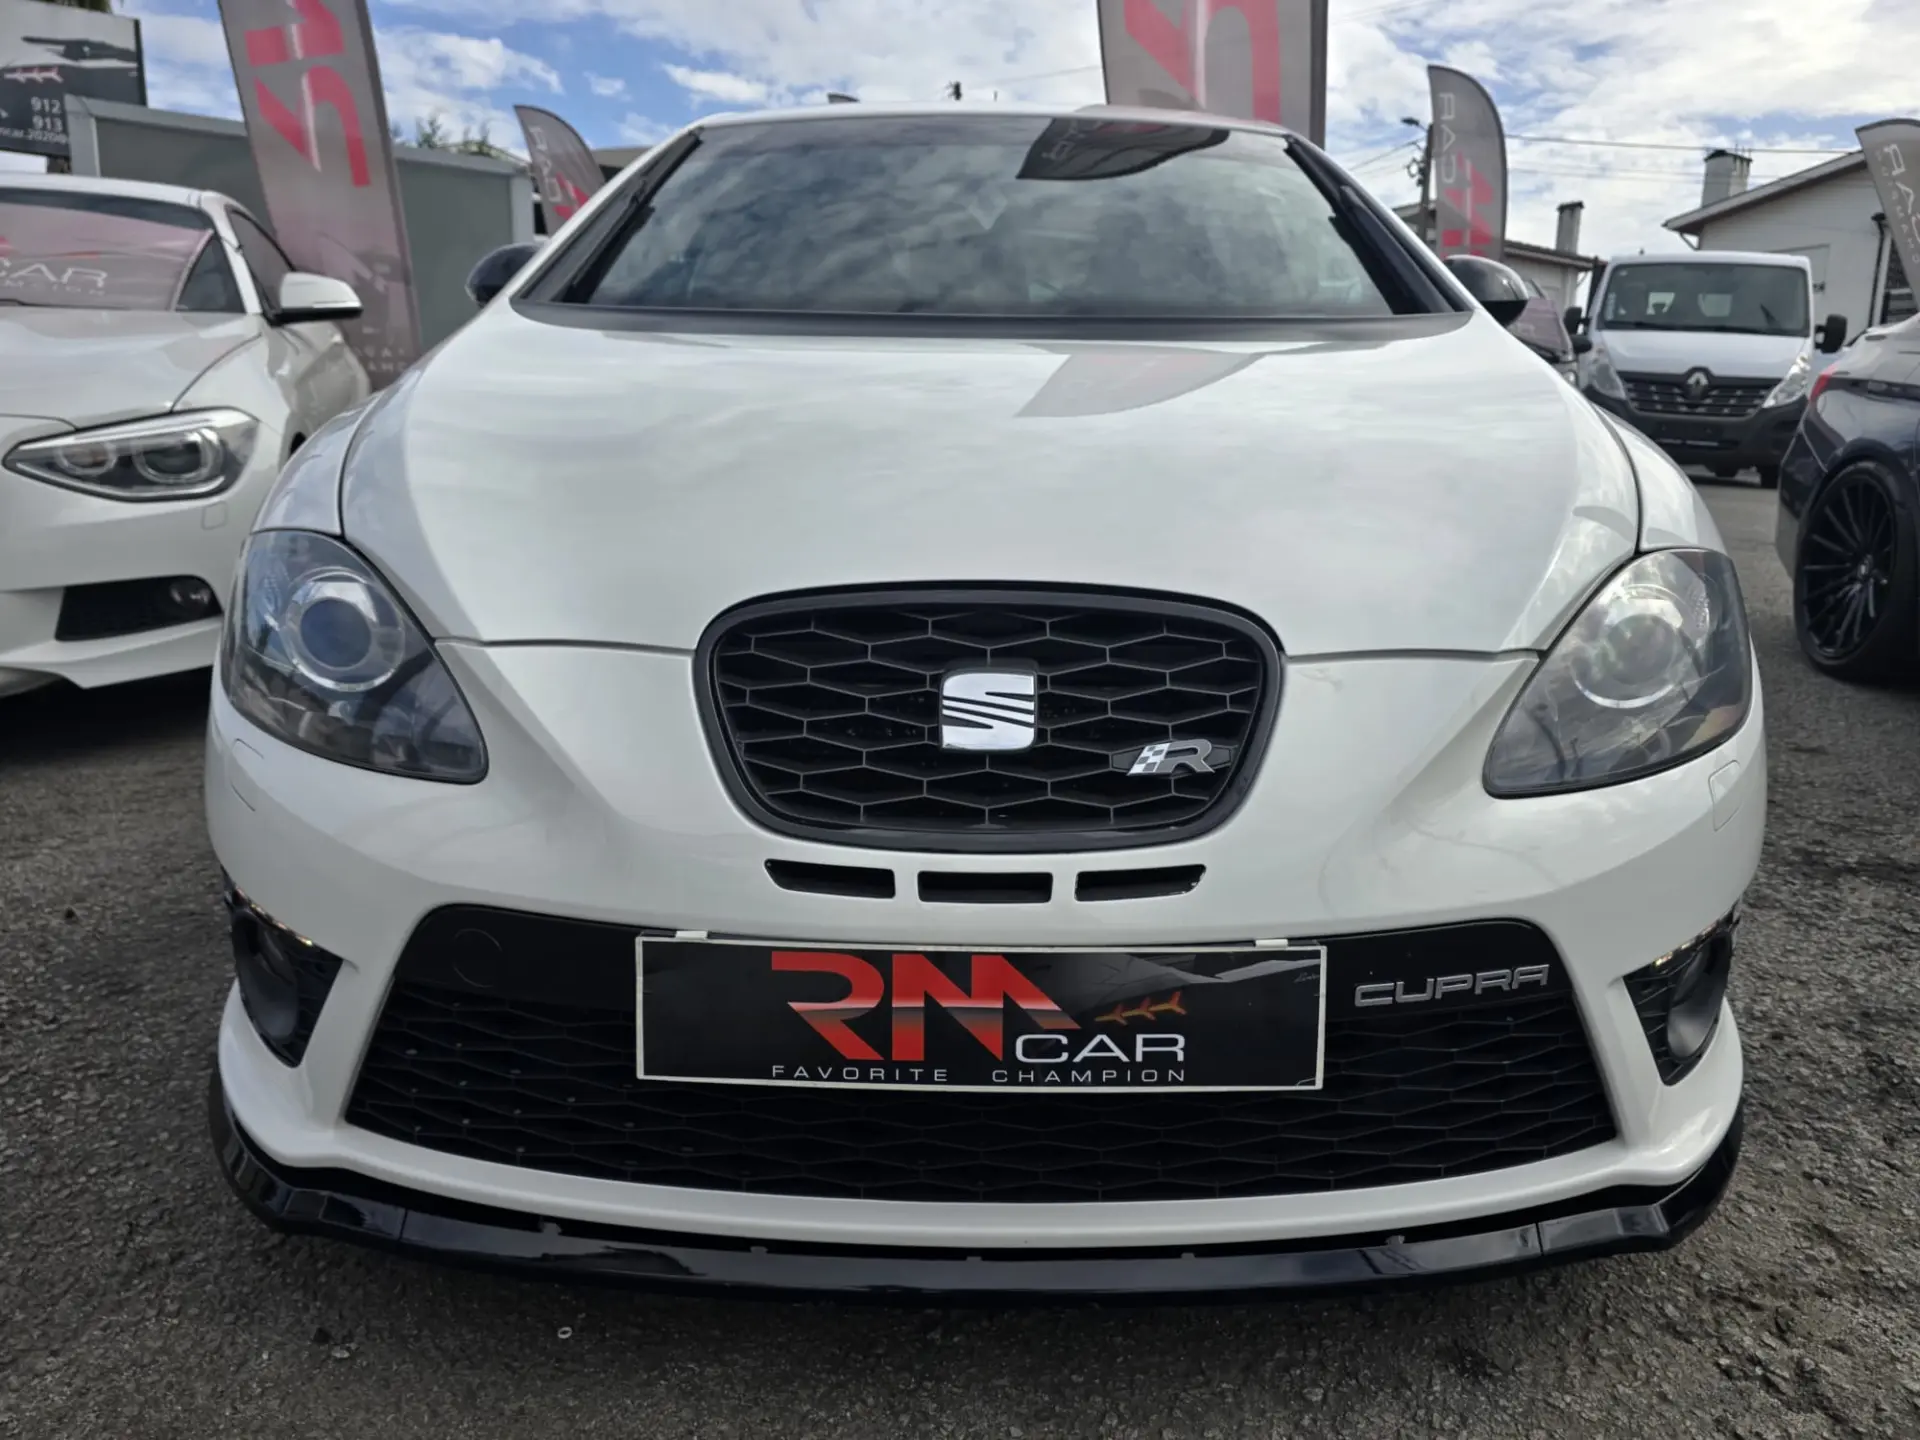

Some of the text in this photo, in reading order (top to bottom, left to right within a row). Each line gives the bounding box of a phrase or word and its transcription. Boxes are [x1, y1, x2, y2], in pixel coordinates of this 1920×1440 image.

[30, 96, 61, 114] 912
[1354, 963, 1550, 1007] CUPRA
[1015, 1033, 1186, 1064] CAR
[771, 1064, 1185, 1083] FAVORITE CHAMPION
